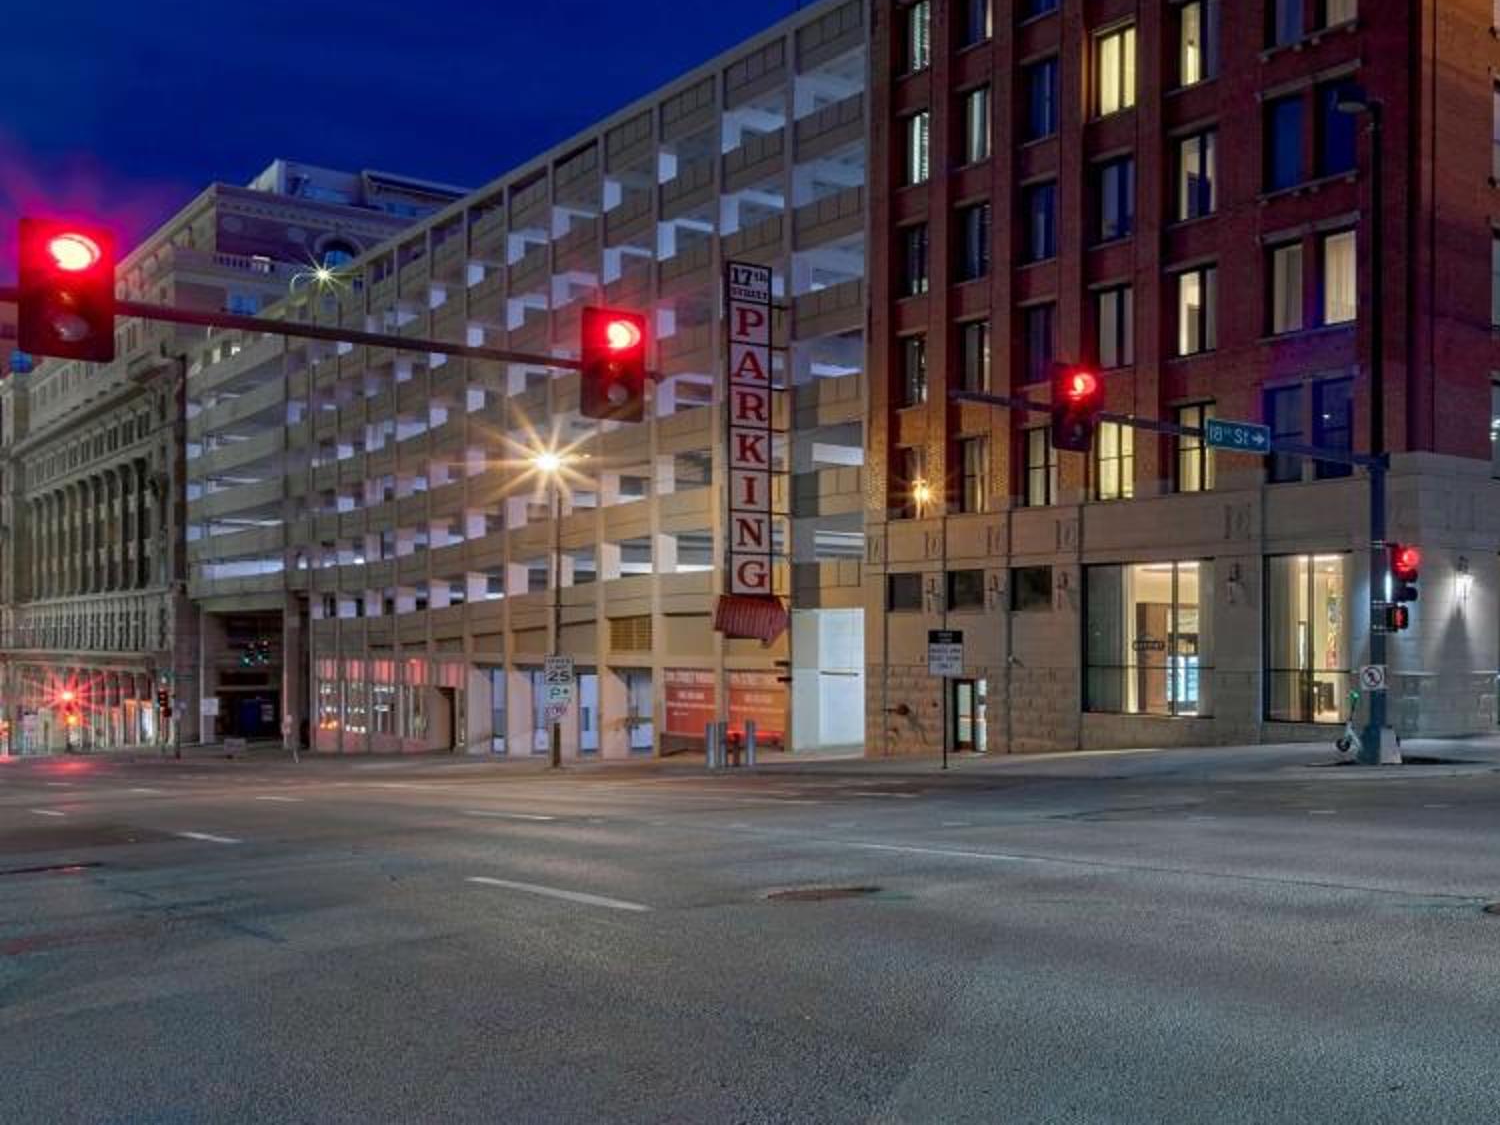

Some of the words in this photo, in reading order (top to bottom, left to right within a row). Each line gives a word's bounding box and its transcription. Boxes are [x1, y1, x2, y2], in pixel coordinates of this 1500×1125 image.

[731, 266, 768, 286] 17th
[1233, 427, 1249, 444] St
[734, 305, 769, 591] PARKING
[548, 670, 571, 682] 25
